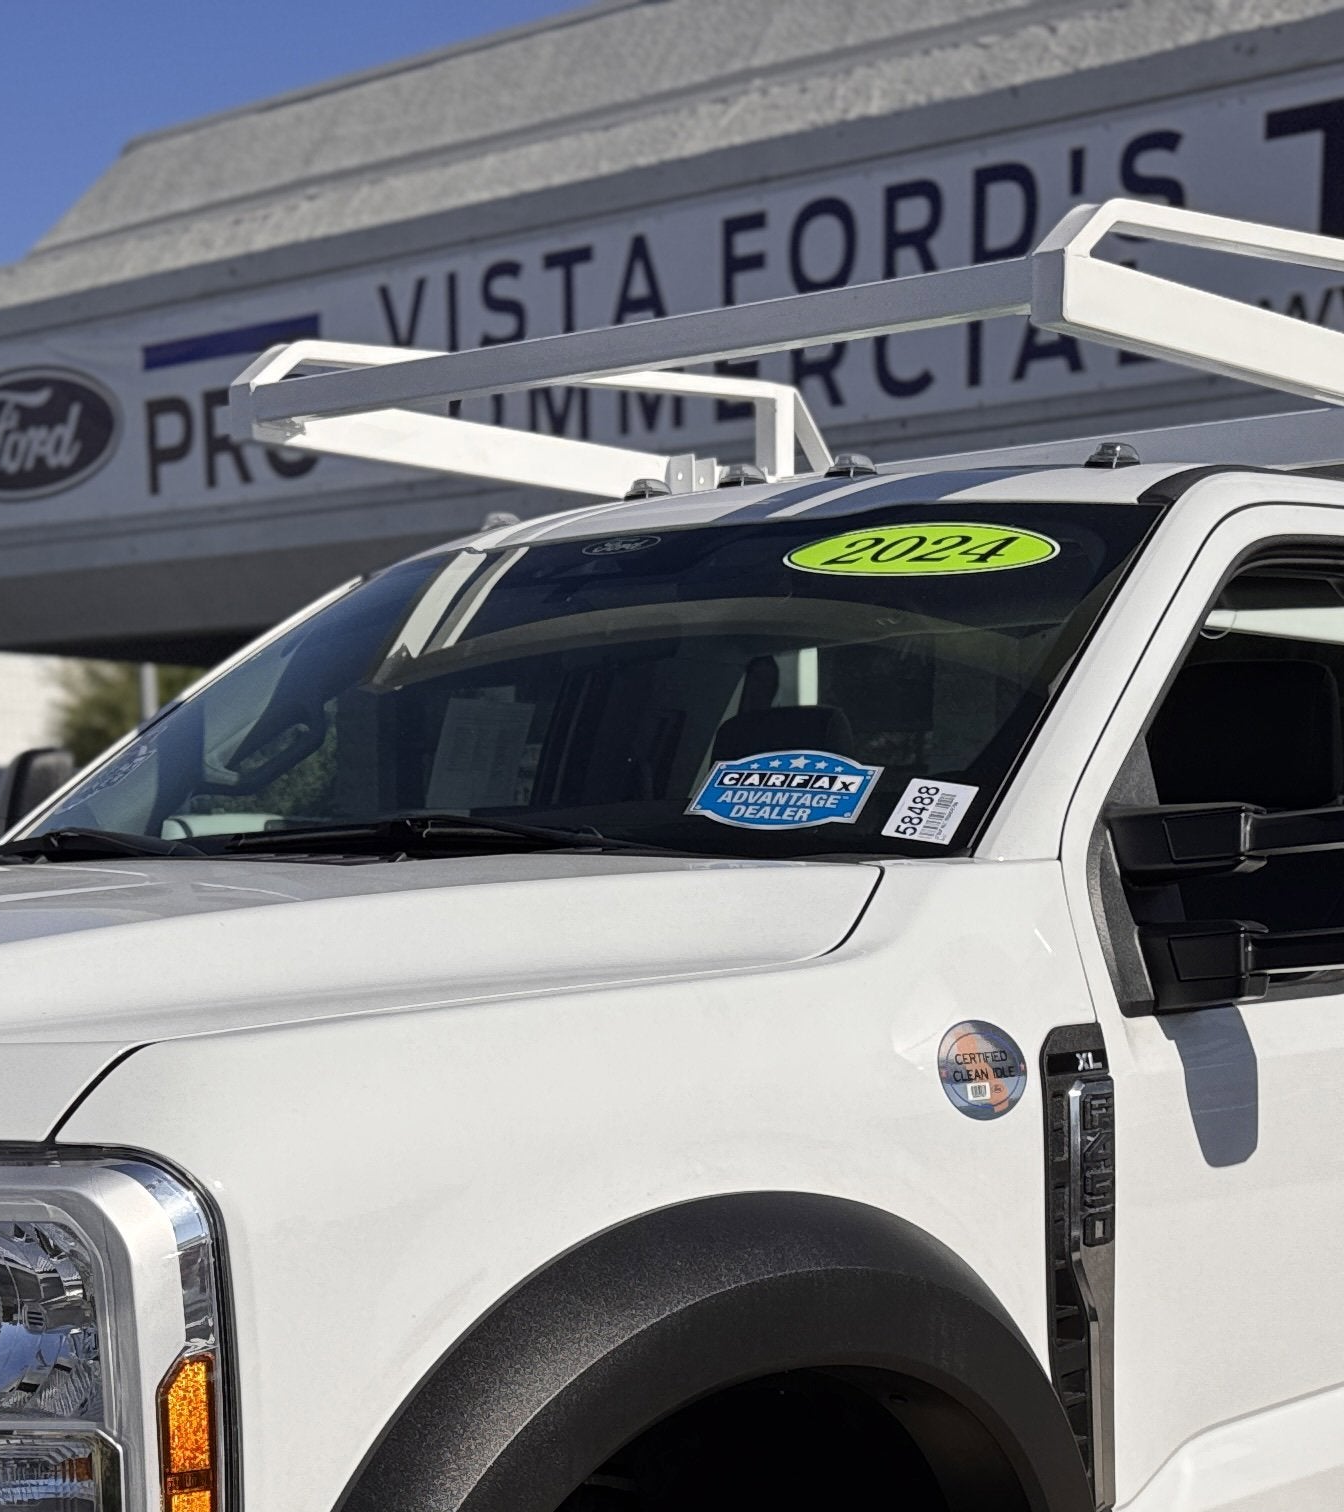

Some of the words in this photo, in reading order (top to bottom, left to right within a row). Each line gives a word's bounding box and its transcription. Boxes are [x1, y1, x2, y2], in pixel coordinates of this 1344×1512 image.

[378, 233, 668, 353] VISTA
[722, 130, 1187, 307] FORD'S
[820, 535, 1020, 566] 2024
[720, 771, 860, 793] CARFAX
[717, 789, 841, 809] ADVANTAGE
[729, 804, 811, 822] DEALER
[894, 785, 940, 837] 58488
[954, 1049, 1008, 1066] CERTIFIED
[1075, 1051, 1103, 1071] XL
[952, 1065, 989, 1083] CLEAN
[992, 1065, 1017, 1080] IDLE
